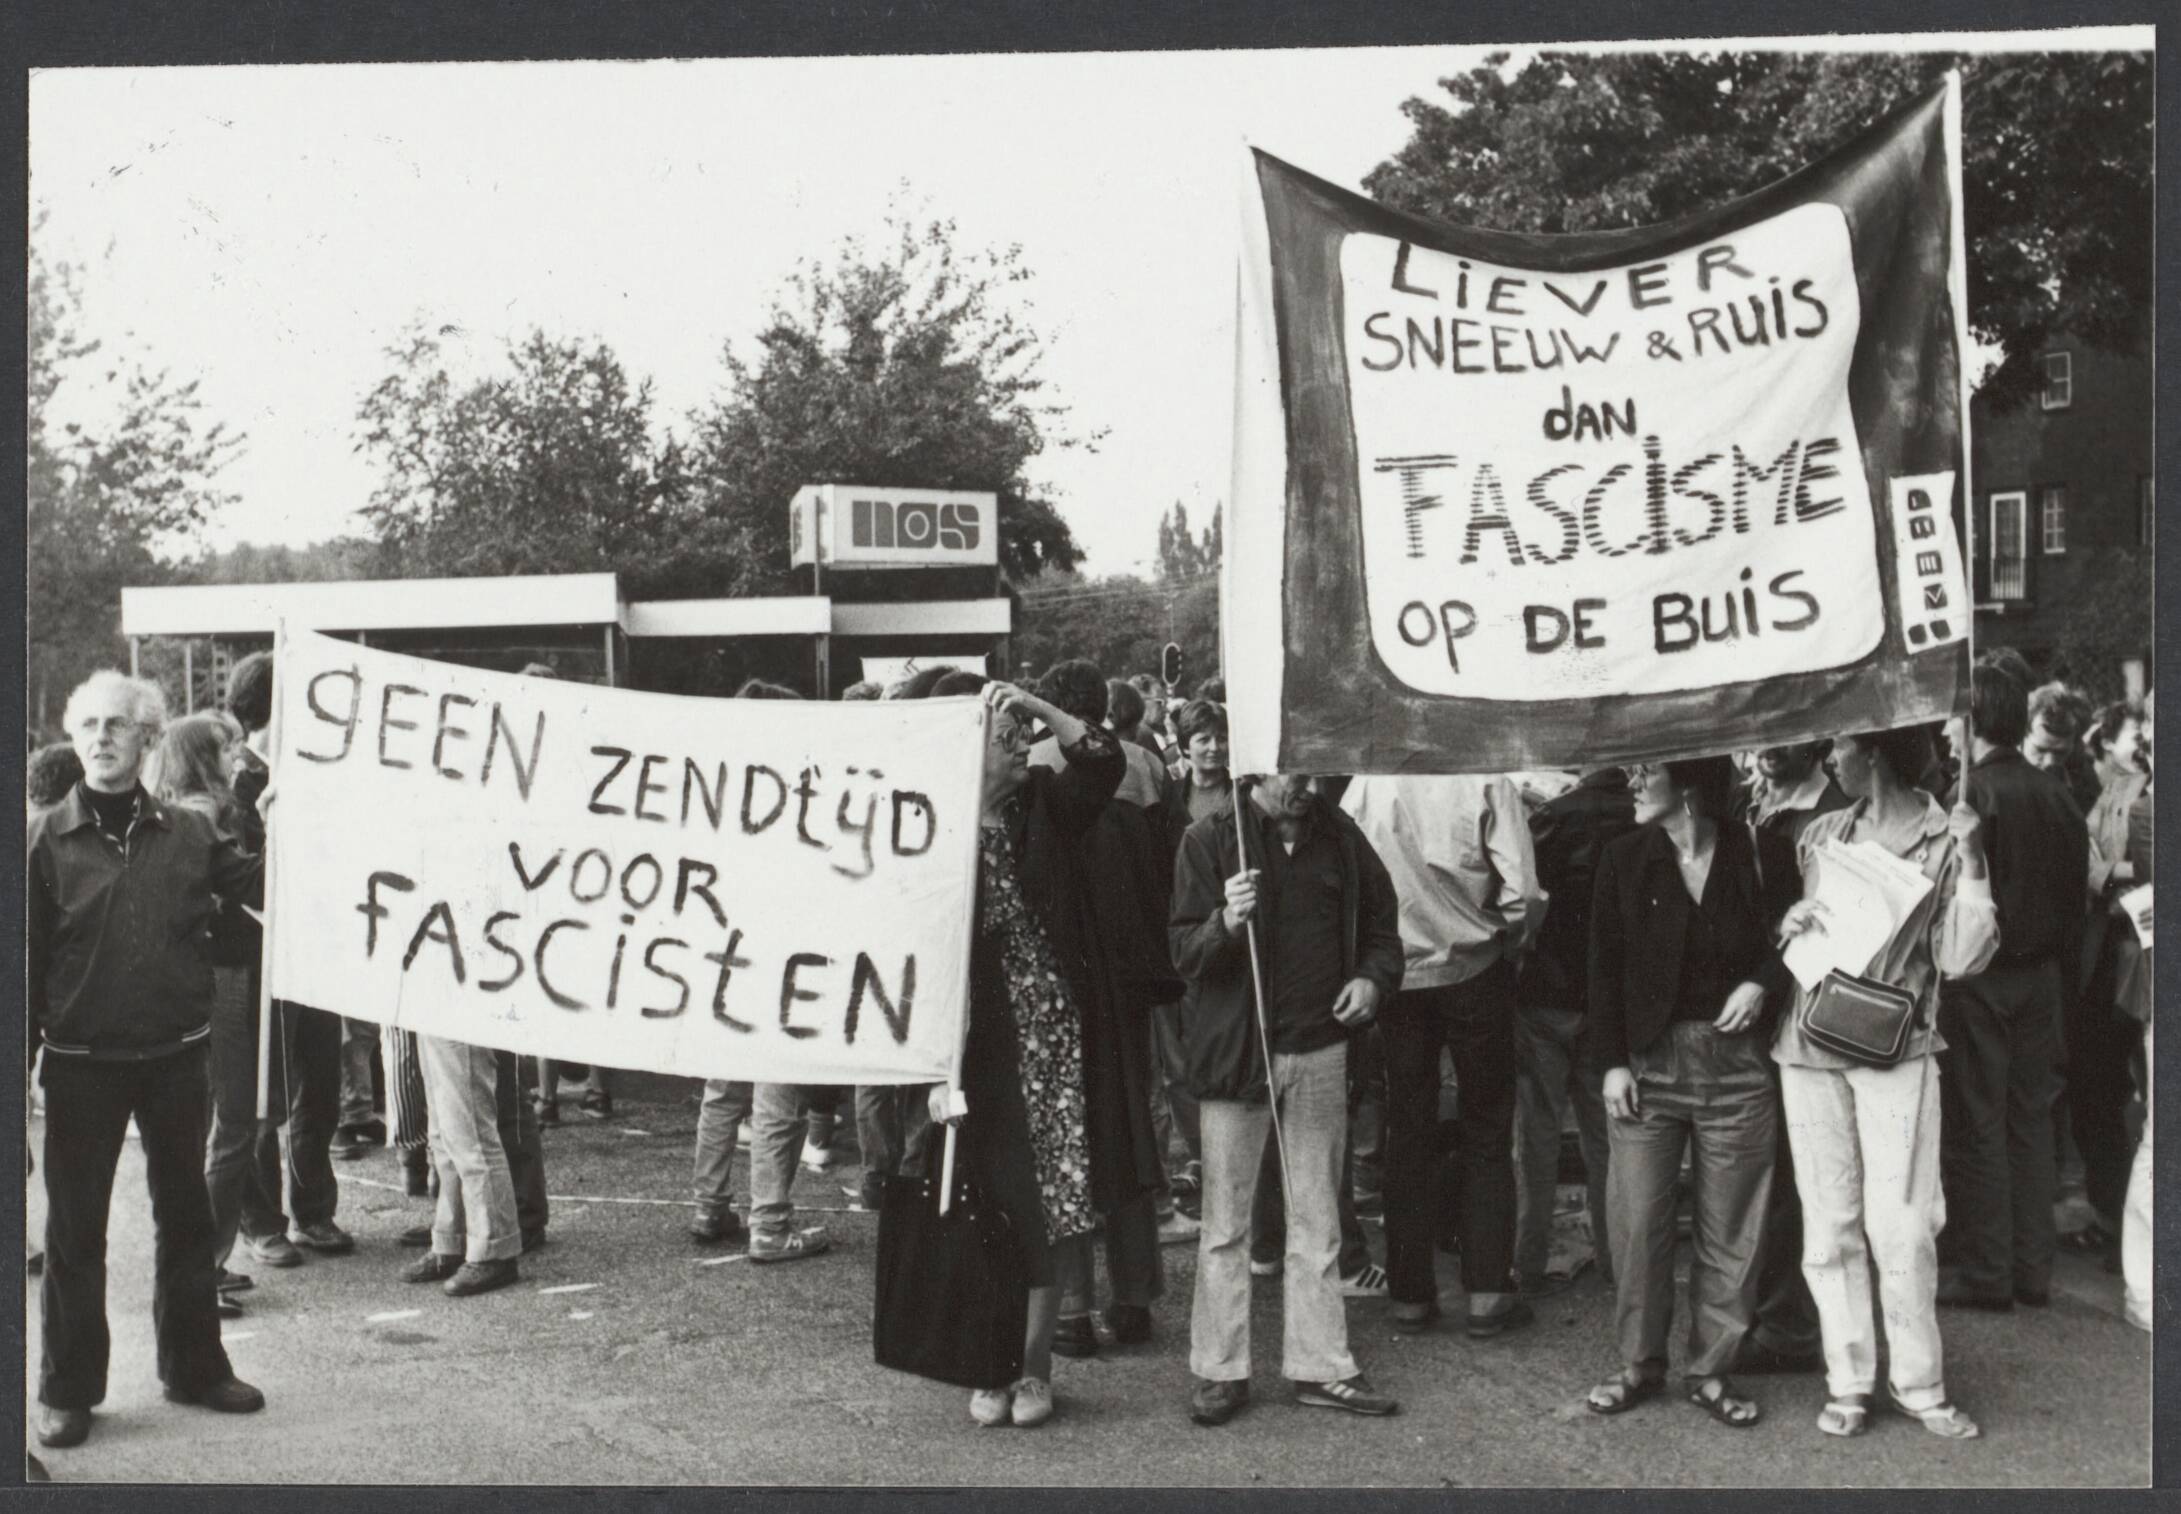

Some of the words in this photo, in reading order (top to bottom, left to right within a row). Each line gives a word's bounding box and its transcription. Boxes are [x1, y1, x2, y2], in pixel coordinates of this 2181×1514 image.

[1361, 311, 1621, 374] SNEEUW
[1646, 330, 1684, 362] &
[1522, 597, 1608, 655] DE
[507, 841, 729, 928] VOOR
